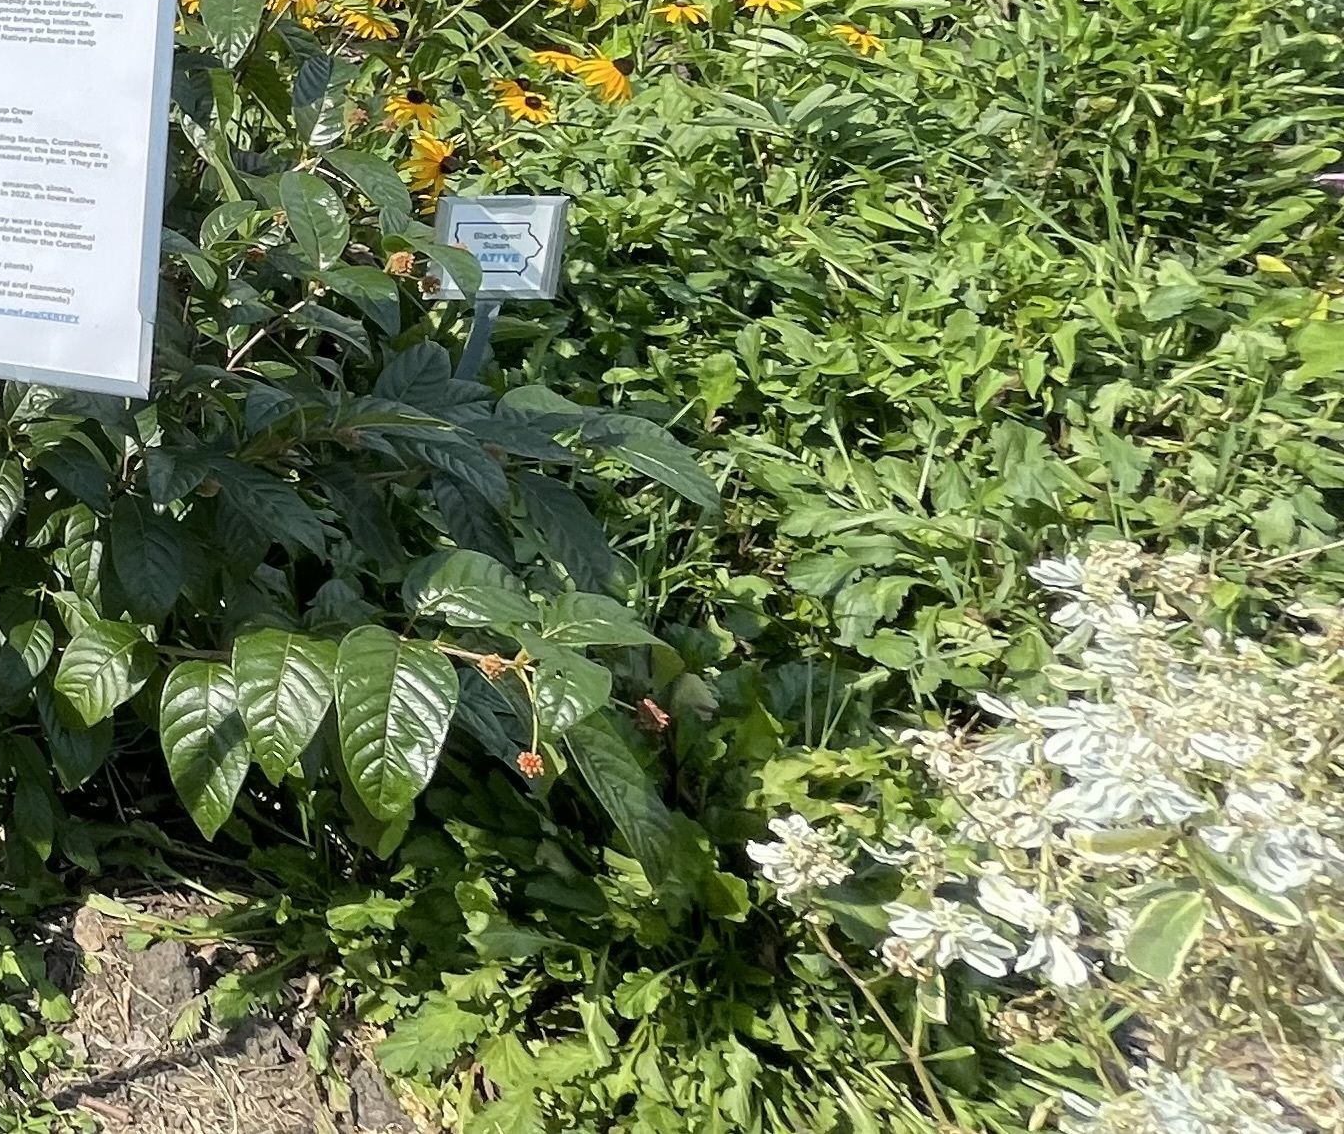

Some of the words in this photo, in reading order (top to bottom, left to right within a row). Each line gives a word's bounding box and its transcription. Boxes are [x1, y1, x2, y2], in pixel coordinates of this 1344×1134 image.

[32, 7, 46, 15] the
[47, 8, 69, 16] color
[71, 9, 81, 17] of
[82, 10, 102, 18] their
[2, 24, 33, 33] flowers
[46, 27, 76, 35] berries
[0, 33, 27, 42] Native
[28, 35, 55, 44] plants
[56, 37, 75, 45] also
[76, 38, 96, 48] help
[10, 107, 33, 116] Crew
[474, 232, 522, 241] Black-eyed
[482, 241, 510, 249] Susan
[477, 252, 520, 263] ATIVE
[11, 281, 28, 289] and
